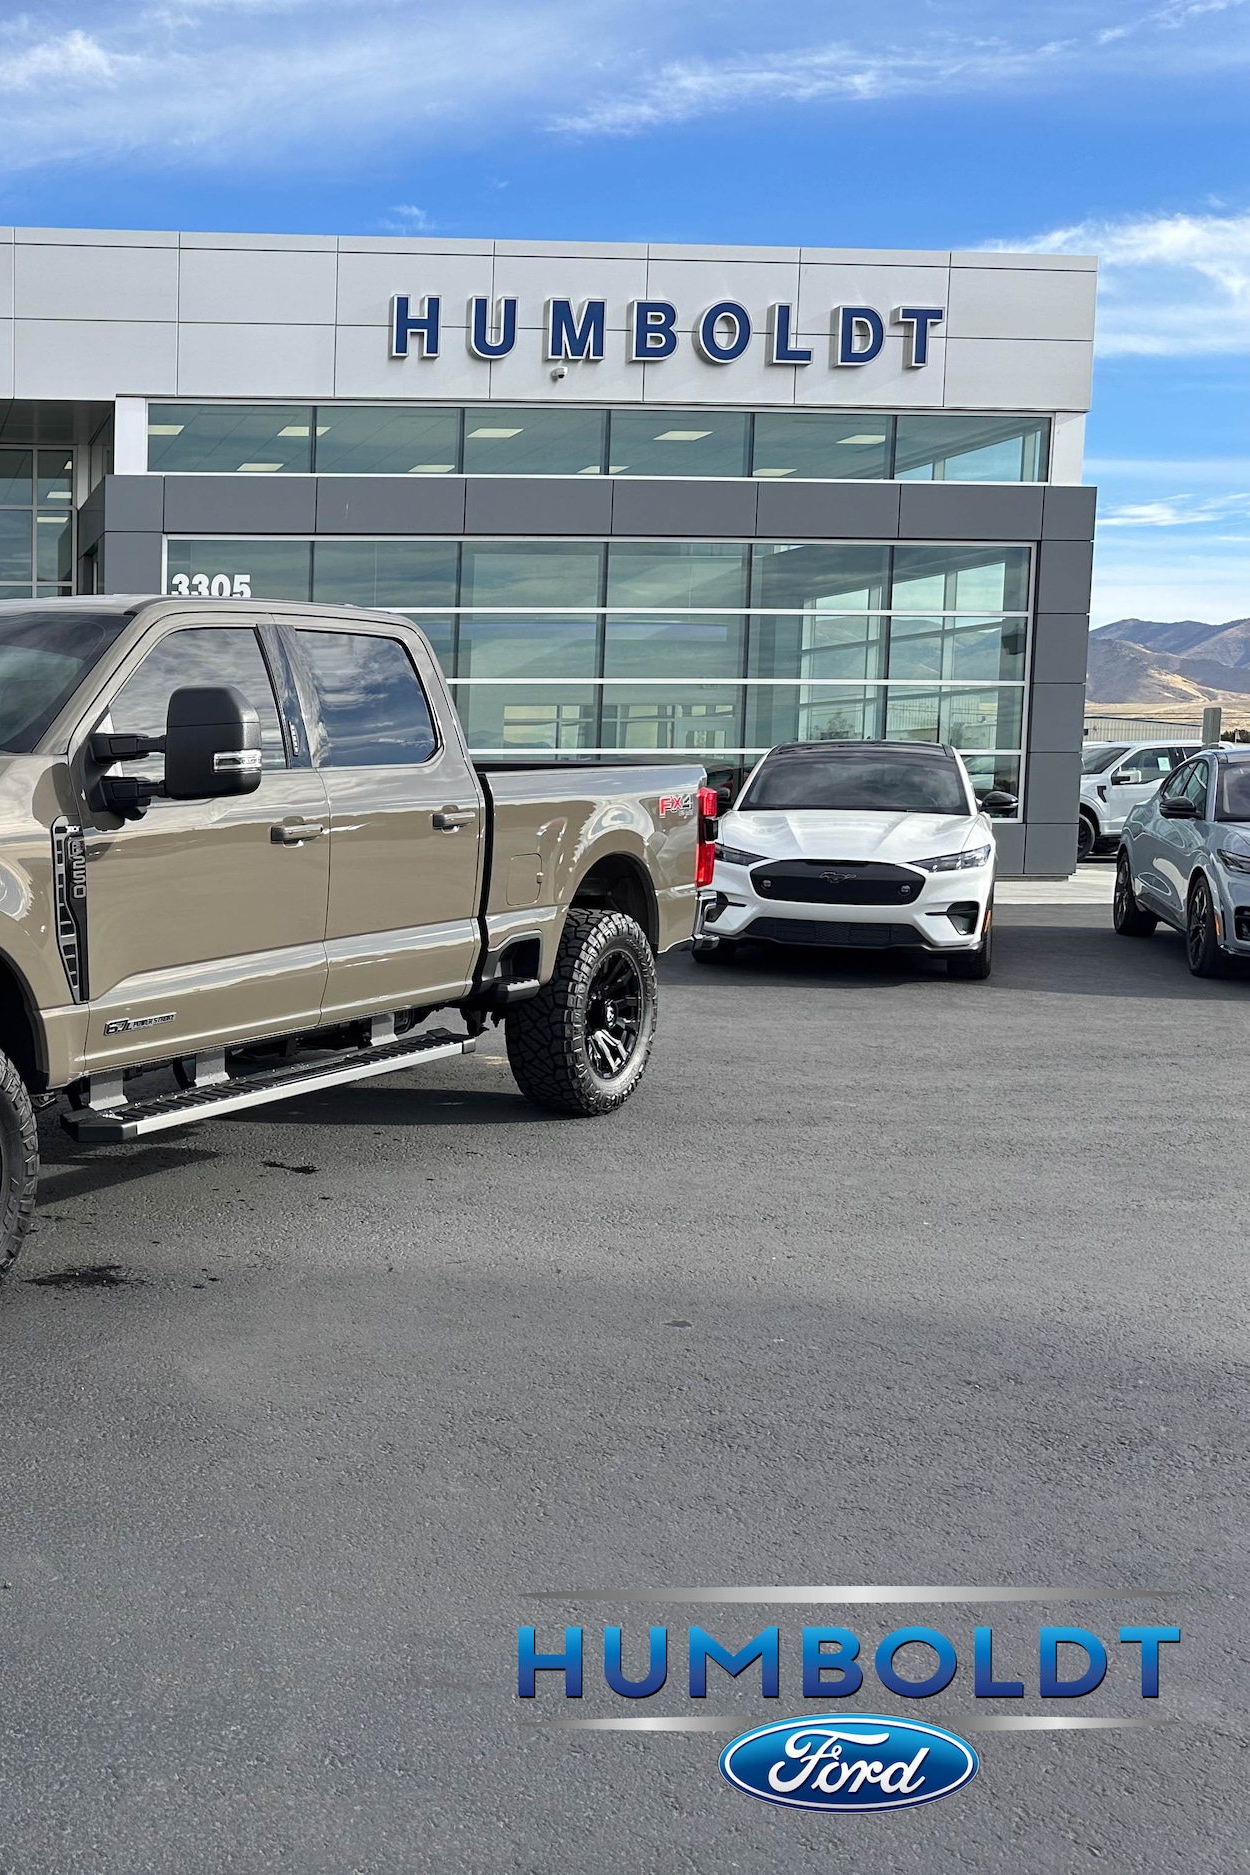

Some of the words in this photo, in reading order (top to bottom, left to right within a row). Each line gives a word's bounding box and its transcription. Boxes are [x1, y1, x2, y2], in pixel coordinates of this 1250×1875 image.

[390, 294, 946, 369] HUMBOLDT
[171, 573, 252, 598] 3305
[659, 794, 693, 816] FX4
